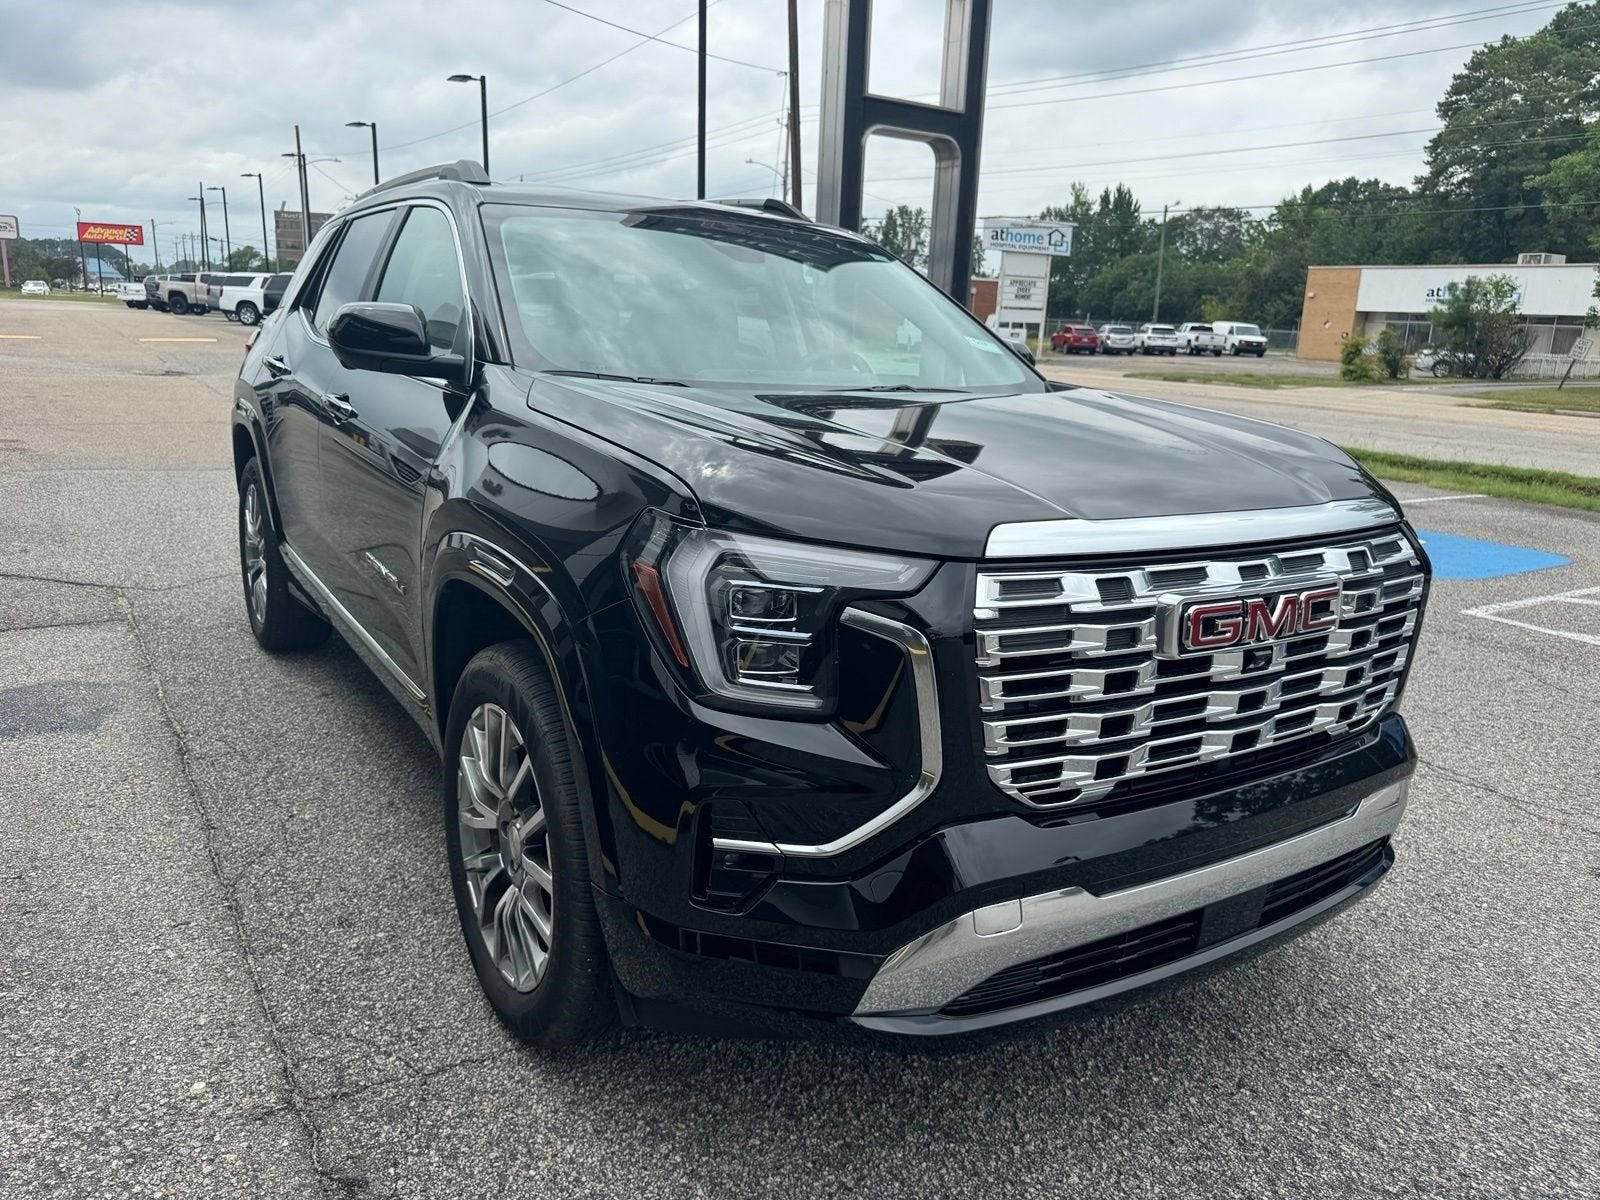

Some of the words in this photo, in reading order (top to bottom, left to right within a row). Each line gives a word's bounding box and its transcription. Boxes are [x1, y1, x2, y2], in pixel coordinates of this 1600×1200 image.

[88, 226, 125, 235] Advance
[82, 232, 102, 240] Auto
[991, 227, 1045, 245] athome
[1010, 279, 1036, 288] APPRECIATE
[1188, 586, 1340, 648] GMC
